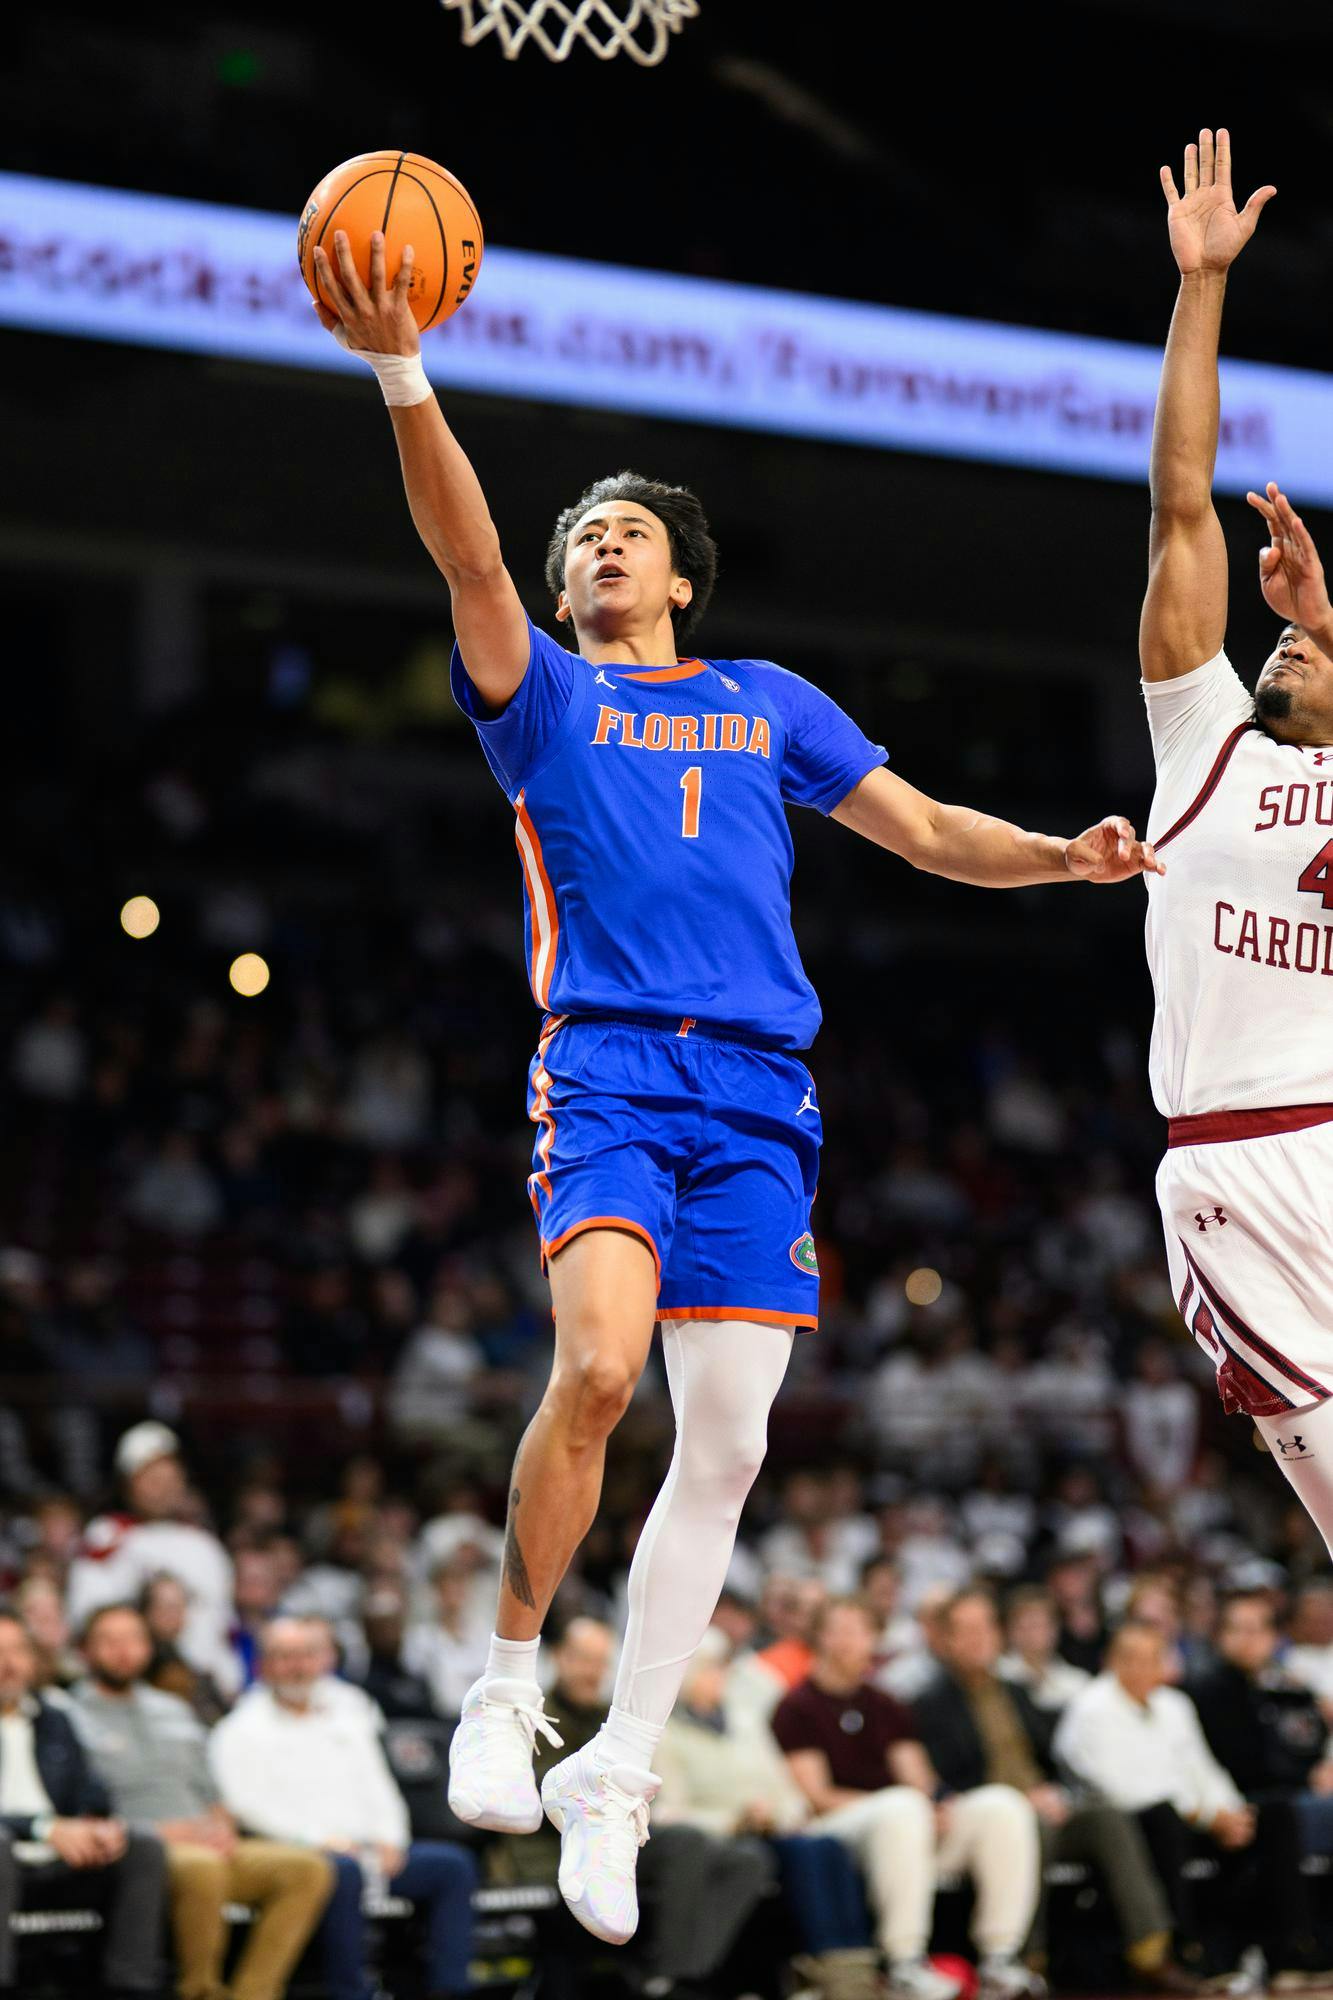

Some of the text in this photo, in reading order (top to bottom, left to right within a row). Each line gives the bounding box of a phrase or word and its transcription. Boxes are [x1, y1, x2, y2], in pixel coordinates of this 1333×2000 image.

[590, 704, 770, 759] FLORIDA
[680, 767, 702, 837] 1
[1297, 838, 1333, 910] 4
